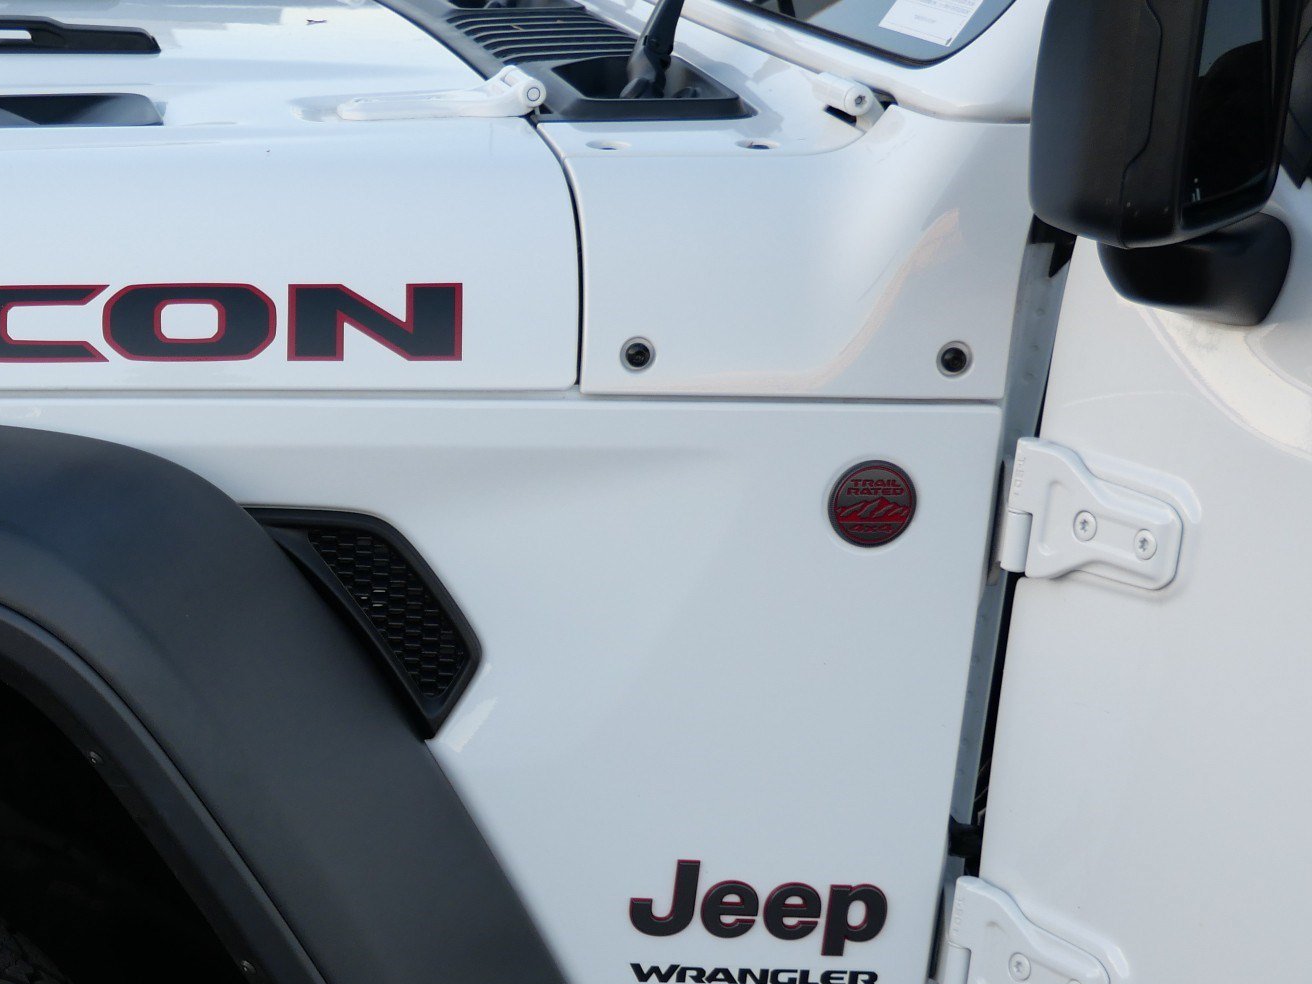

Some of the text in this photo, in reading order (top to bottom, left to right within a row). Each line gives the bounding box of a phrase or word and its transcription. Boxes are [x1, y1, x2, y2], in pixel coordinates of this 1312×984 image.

[850, 479, 901, 488] TRAIL
[846, 487, 905, 496] RATED
[629, 859, 888, 957] Jeep
